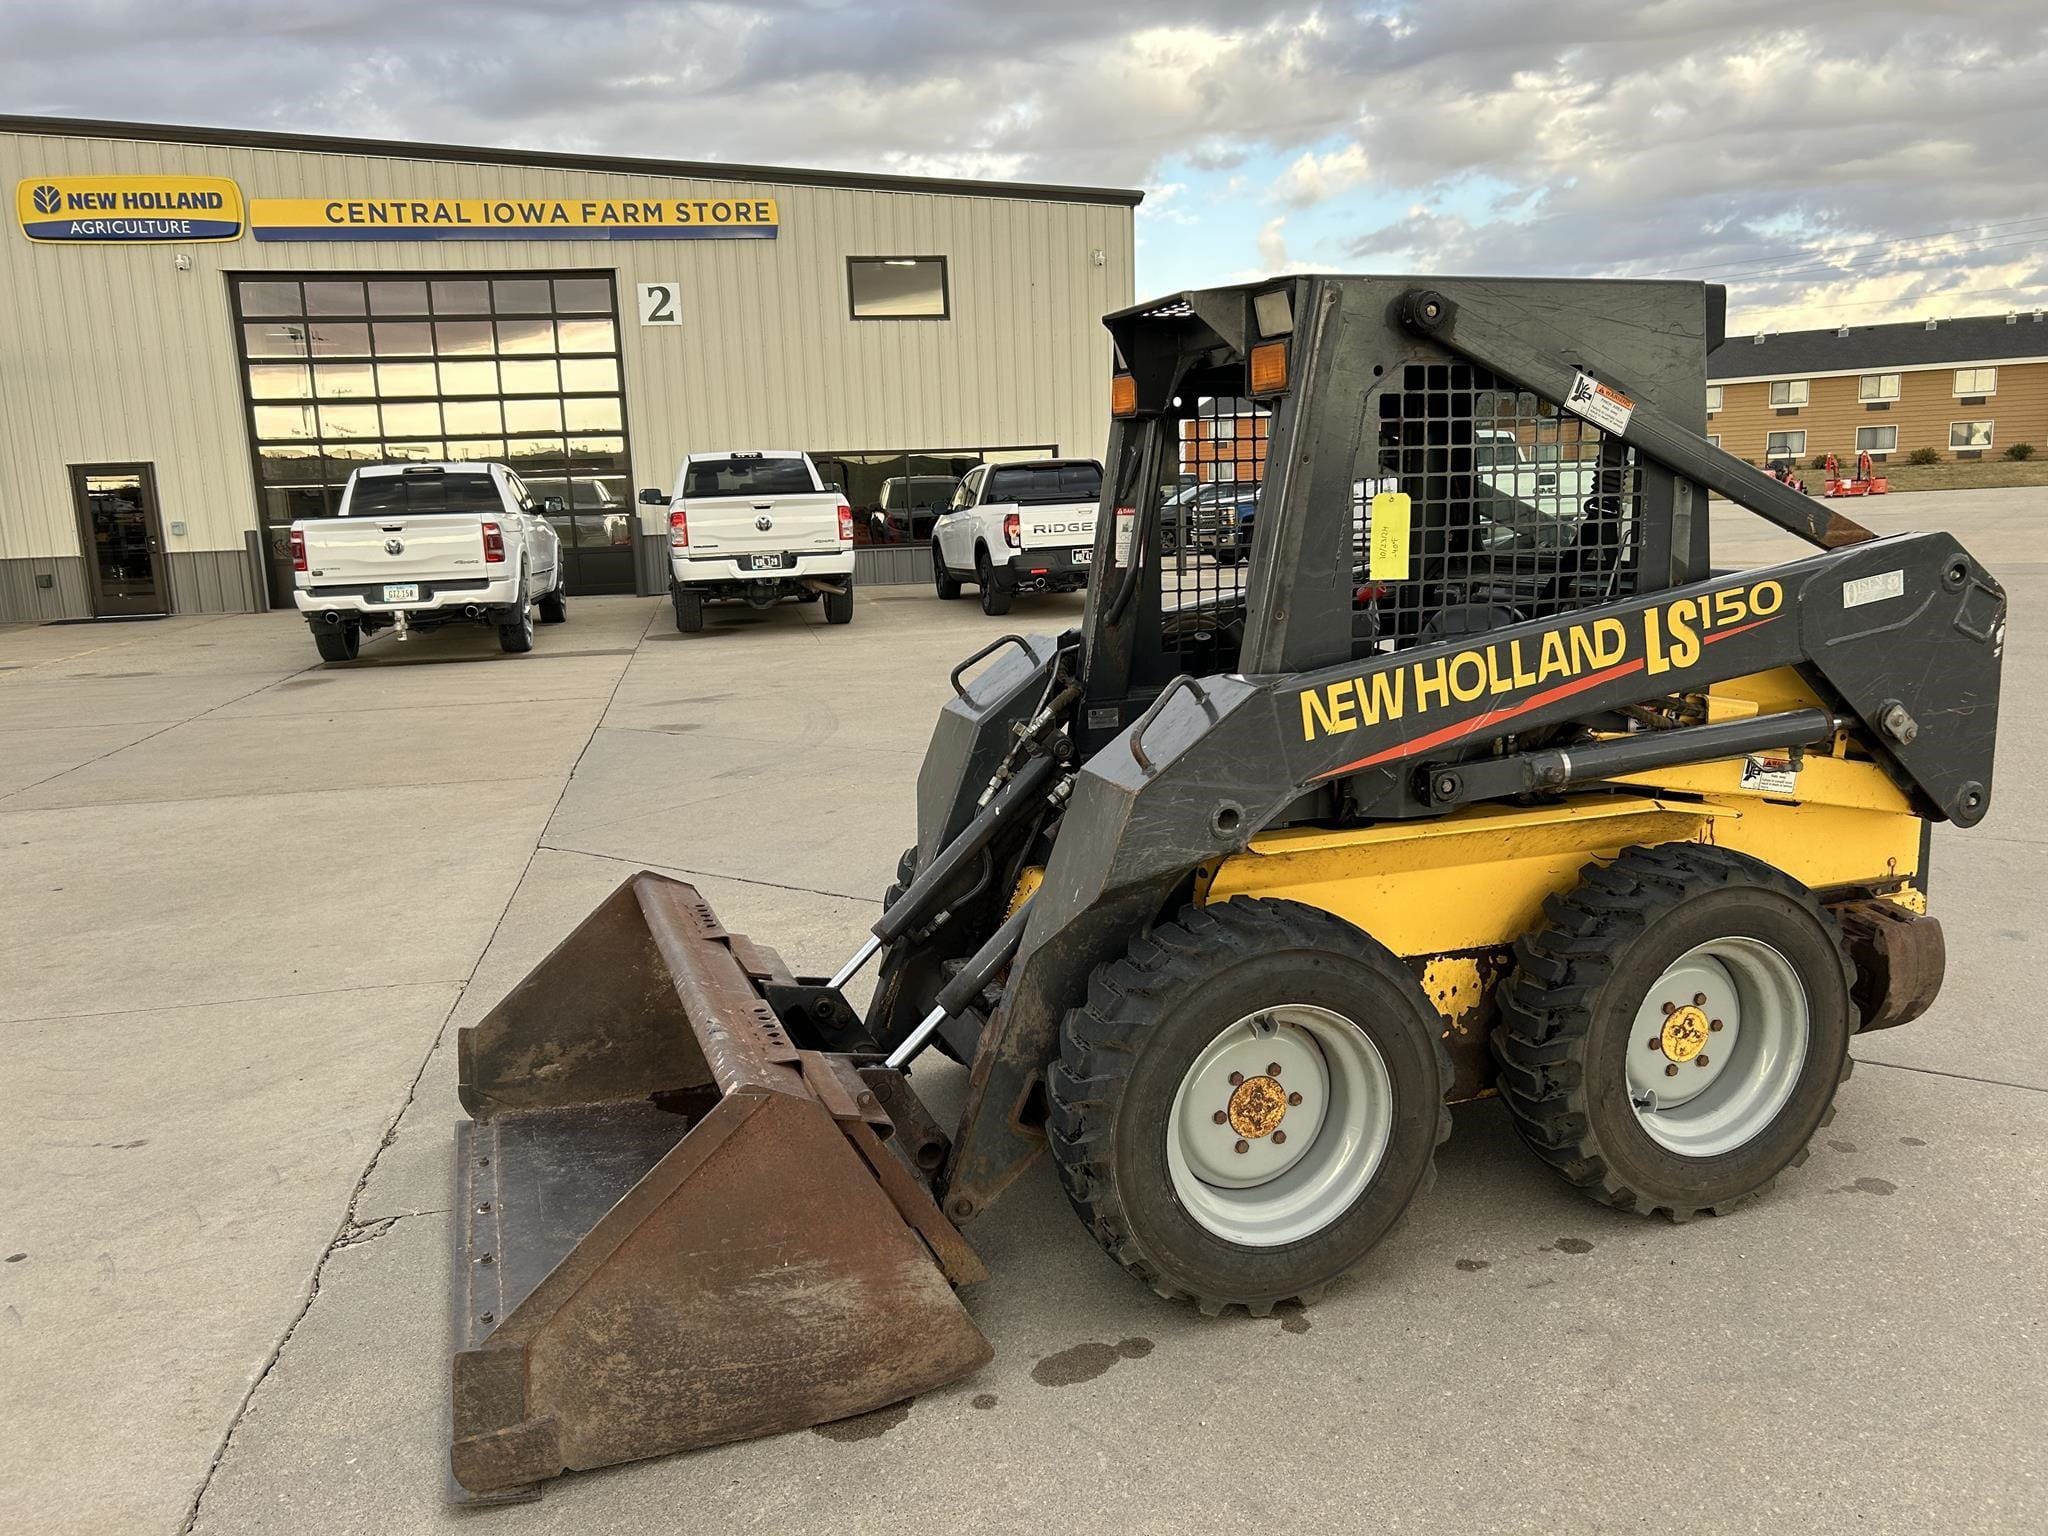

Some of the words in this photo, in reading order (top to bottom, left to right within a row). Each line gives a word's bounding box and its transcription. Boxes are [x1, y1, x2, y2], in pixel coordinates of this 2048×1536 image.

[67, 192, 117, 210] NEW
[122, 192, 223, 210] HOLLAND
[325, 202, 472, 224] CENTRAL
[483, 202, 570, 224] IOWA
[581, 202, 664, 223] FARM
[675, 202, 771, 223] STORE
[70, 220, 191, 235] AGRICULTURE
[647, 285, 675, 322] 2
[1033, 522, 1096, 534] RIDGE
[1300, 666, 1405, 742] NEW
[1413, 617, 1627, 714] HOLLAND
